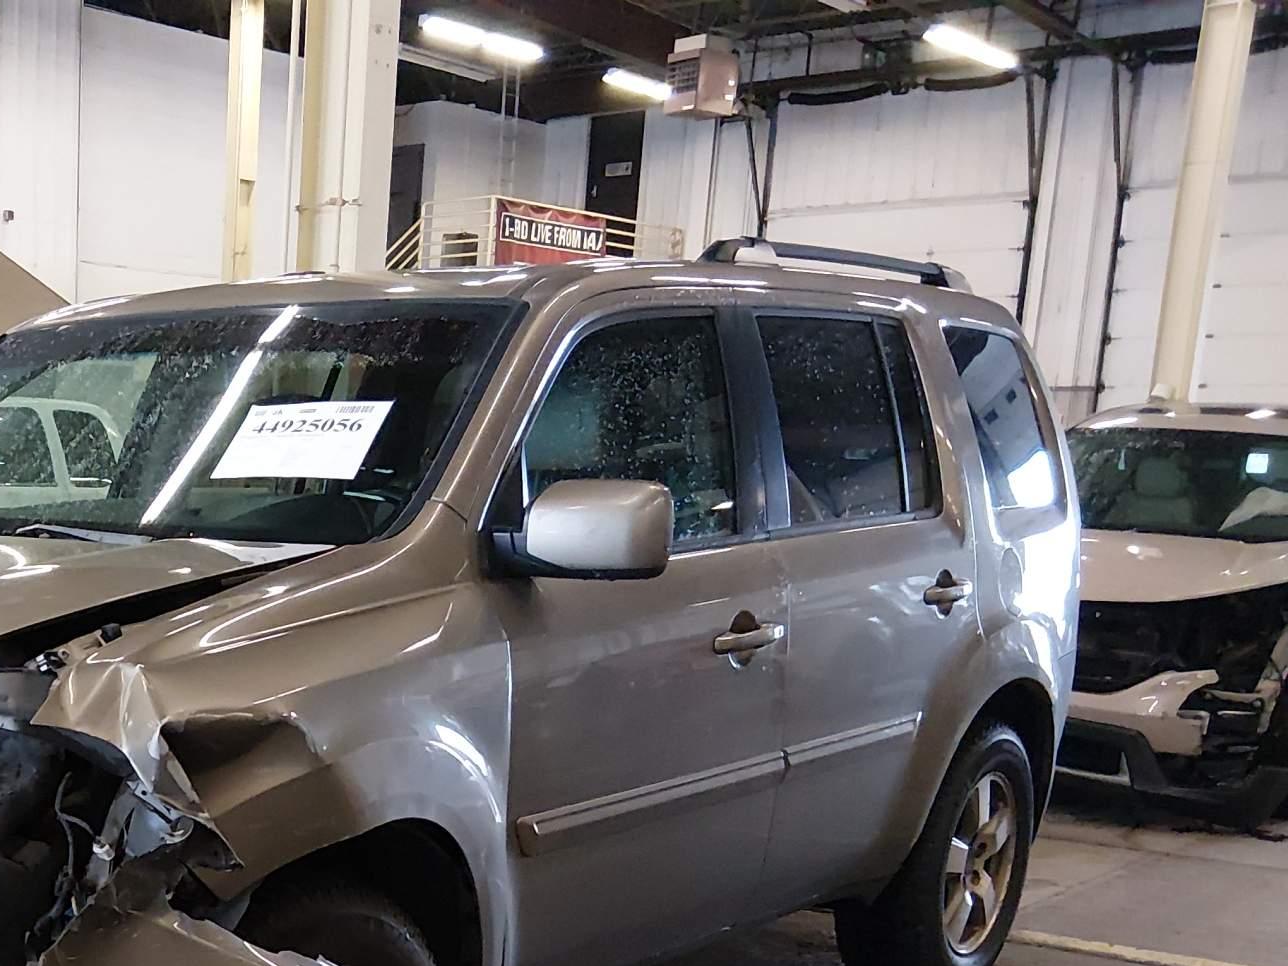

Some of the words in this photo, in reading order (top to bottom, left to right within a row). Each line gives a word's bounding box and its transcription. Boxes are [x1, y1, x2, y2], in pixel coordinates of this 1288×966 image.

[530, 222, 554, 244] LIVE
[553, 226, 581, 250] FROM
[252, 418, 364, 434] 44925056
